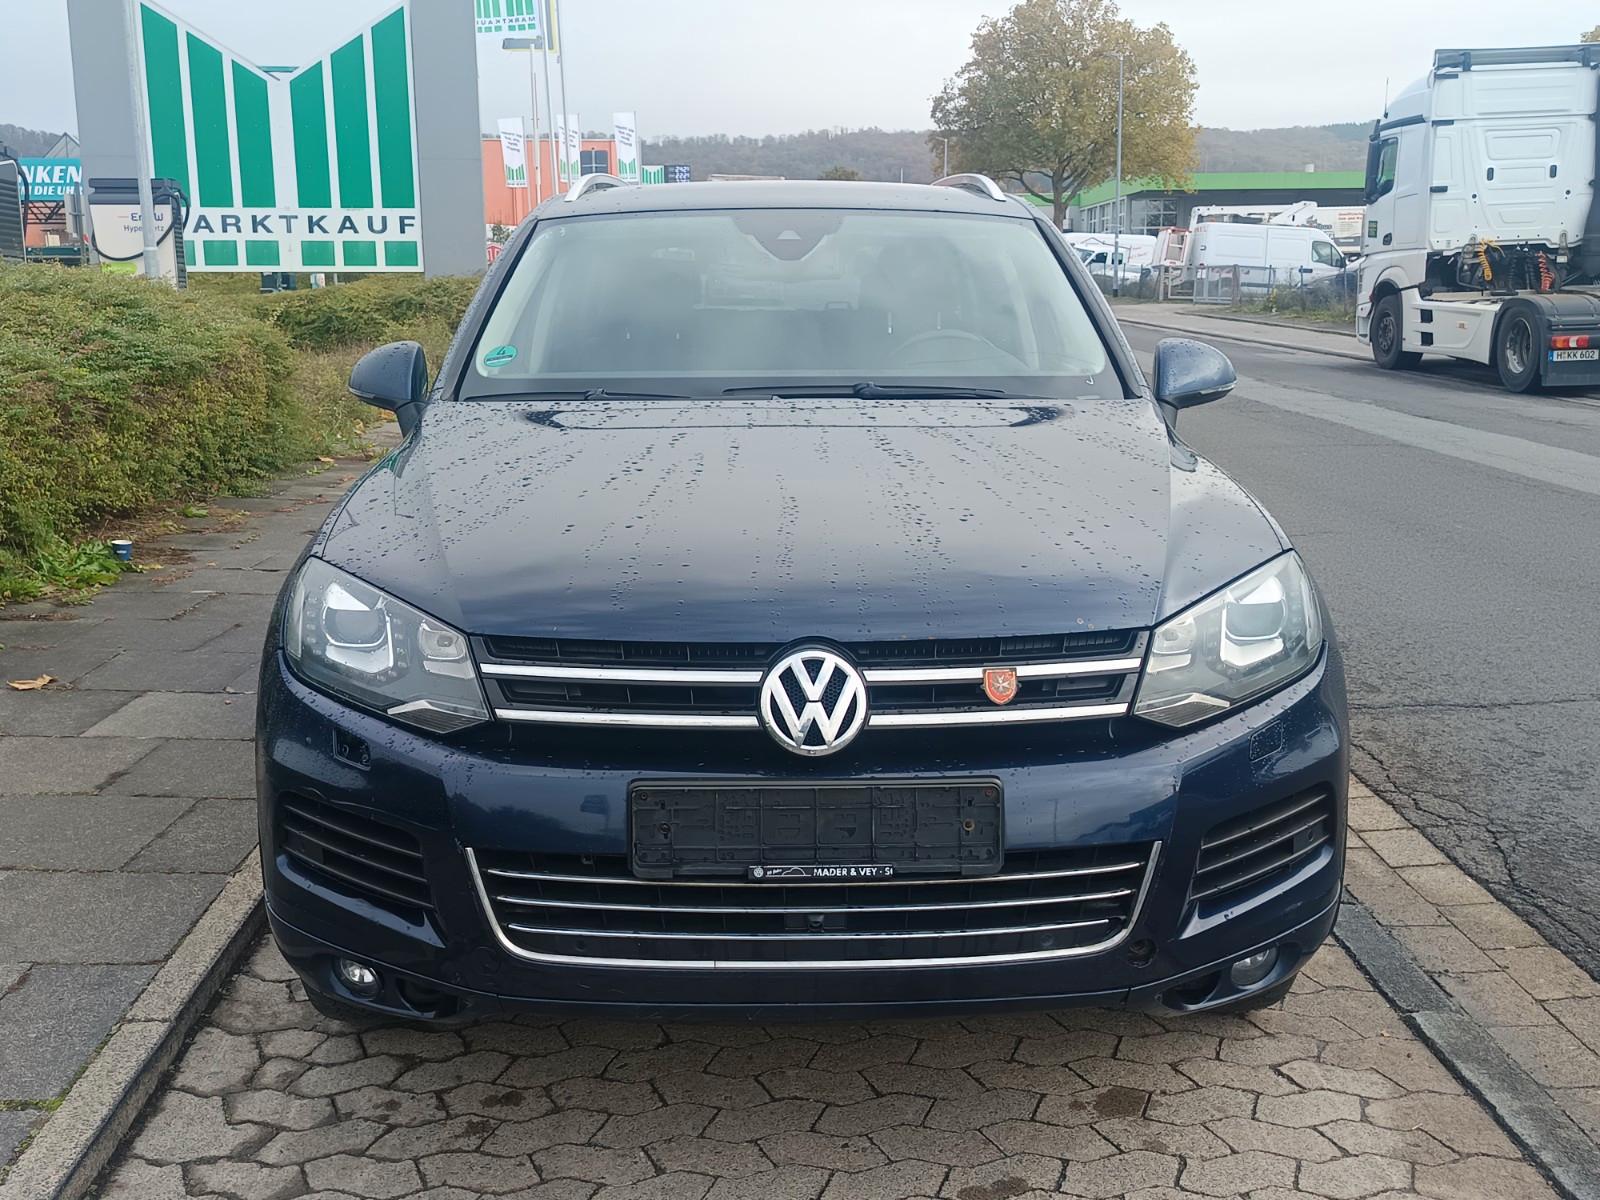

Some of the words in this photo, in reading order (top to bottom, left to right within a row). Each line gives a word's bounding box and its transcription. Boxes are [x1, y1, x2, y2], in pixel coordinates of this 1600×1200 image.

[20, 165, 82, 183] NKEN
[34, 186, 55, 195] DIE
[192, 214, 416, 234] ARKTKAUF
[1556, 351, 1563, 360] H
[1567, 351, 1578, 359] KK
[1580, 350, 1596, 359] 602
[813, 868, 848, 876] MADER
[850, 867, 857, 876] &
[858, 867, 877, 876] VEY
